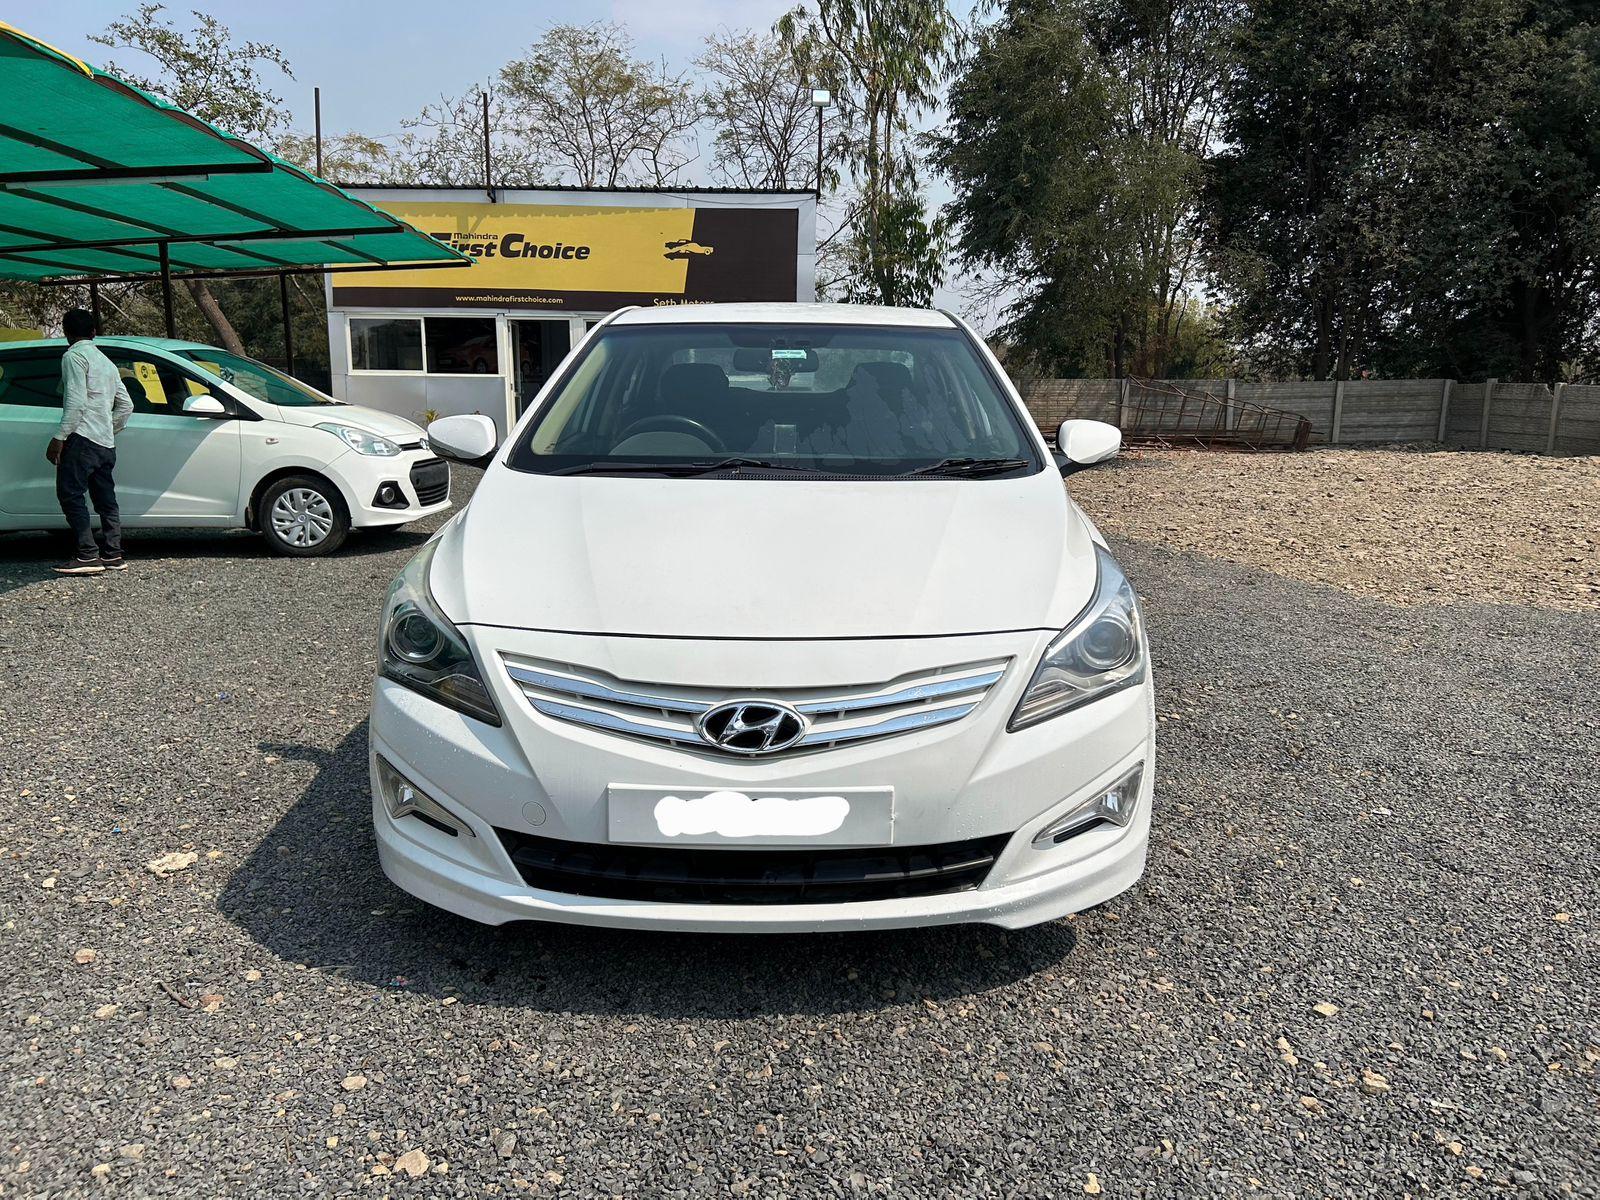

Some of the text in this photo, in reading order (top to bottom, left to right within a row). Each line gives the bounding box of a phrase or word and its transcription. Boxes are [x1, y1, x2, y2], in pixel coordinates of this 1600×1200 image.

[453, 232, 499, 240] Mahindra
[500, 233, 591, 260] Choice
[455, 295, 564, 304] www.mahindrafirstchoice.com
[653, 298, 677, 307] Seth
